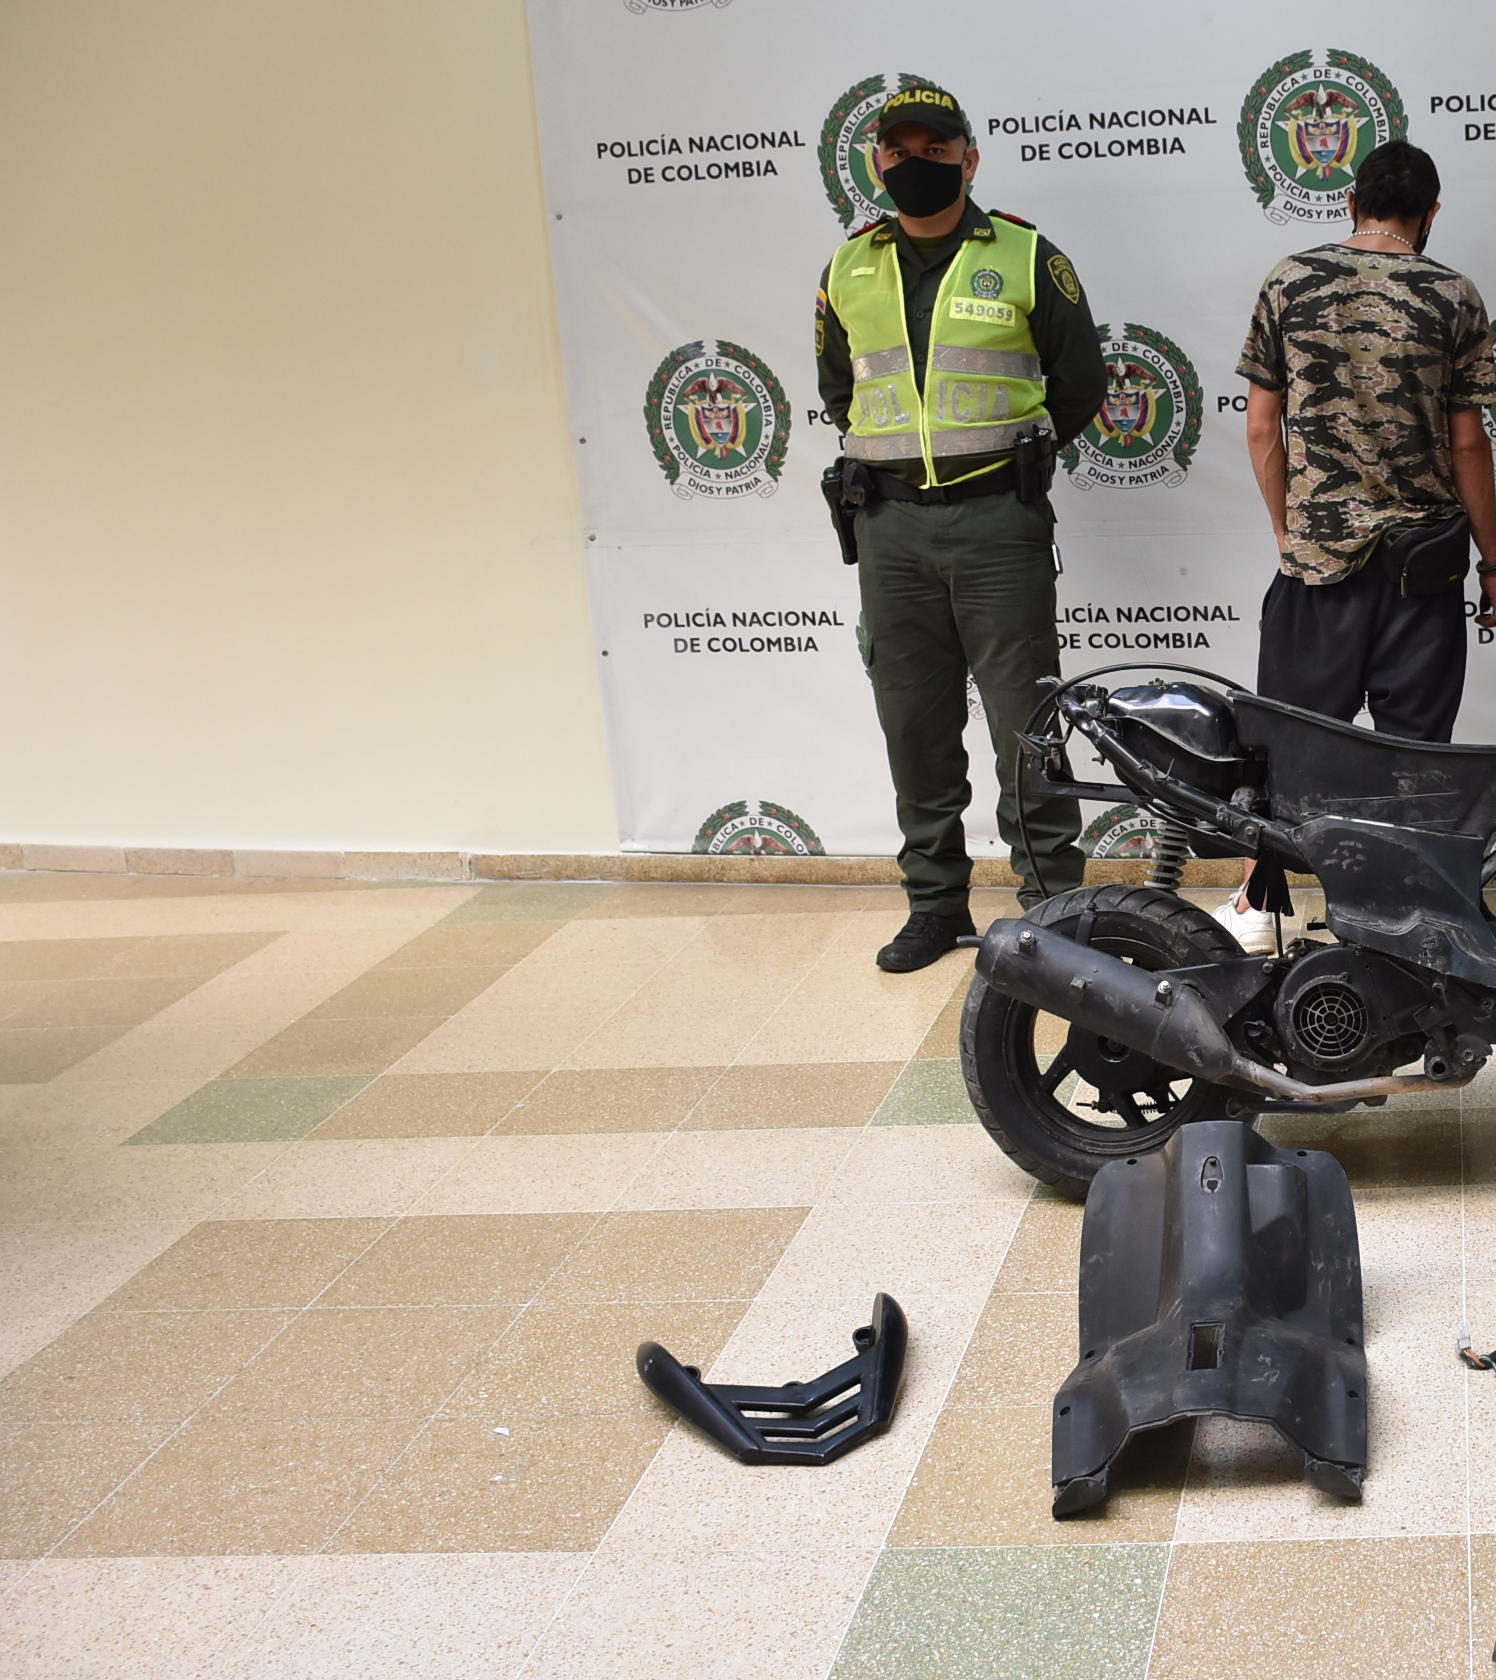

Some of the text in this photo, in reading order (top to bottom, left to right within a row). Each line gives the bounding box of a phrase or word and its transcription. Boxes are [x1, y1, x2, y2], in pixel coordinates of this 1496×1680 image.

[884, 90, 954, 113] POLICIA
[1313, 69, 1332, 79] DE
[1346, 76, 1387, 144] COLOMBIA
[988, 107, 1217, 136] POLICÍA NACIONAL
[1464, 123, 1496, 141] DE
[597, 130, 806, 159] POLICÍA NACIONAL
[1020, 136, 1185, 161] DE COLOMBIA
[627, 159, 778, 185] DE COLOMBIA
[1326, 207, 1348, 219] PAT
[955, 302, 1013, 321] 549059
[1111, 342, 1129, 352] DE
[1143, 349, 1184, 414] COLOMBIA
[705, 359, 722, 367] DE
[735, 365, 773, 427] COLOMBIA
[1128, 428, 1181, 470] NACIONAL
[725, 443, 769, 480] NACIONAL
[726, 476, 762, 495] PATRIA
[1129, 465, 1170, 485] PATRIA
[643, 607, 845, 629] POLICÍA NACIONAL
[1116, 605, 1241, 623] NACIONAL
[673, 636, 819, 653] DE COLOMBIA
[1088, 632, 1210, 649] COLOMBIA
[749, 817, 765, 826] DE
[1139, 819, 1157, 827] DE
